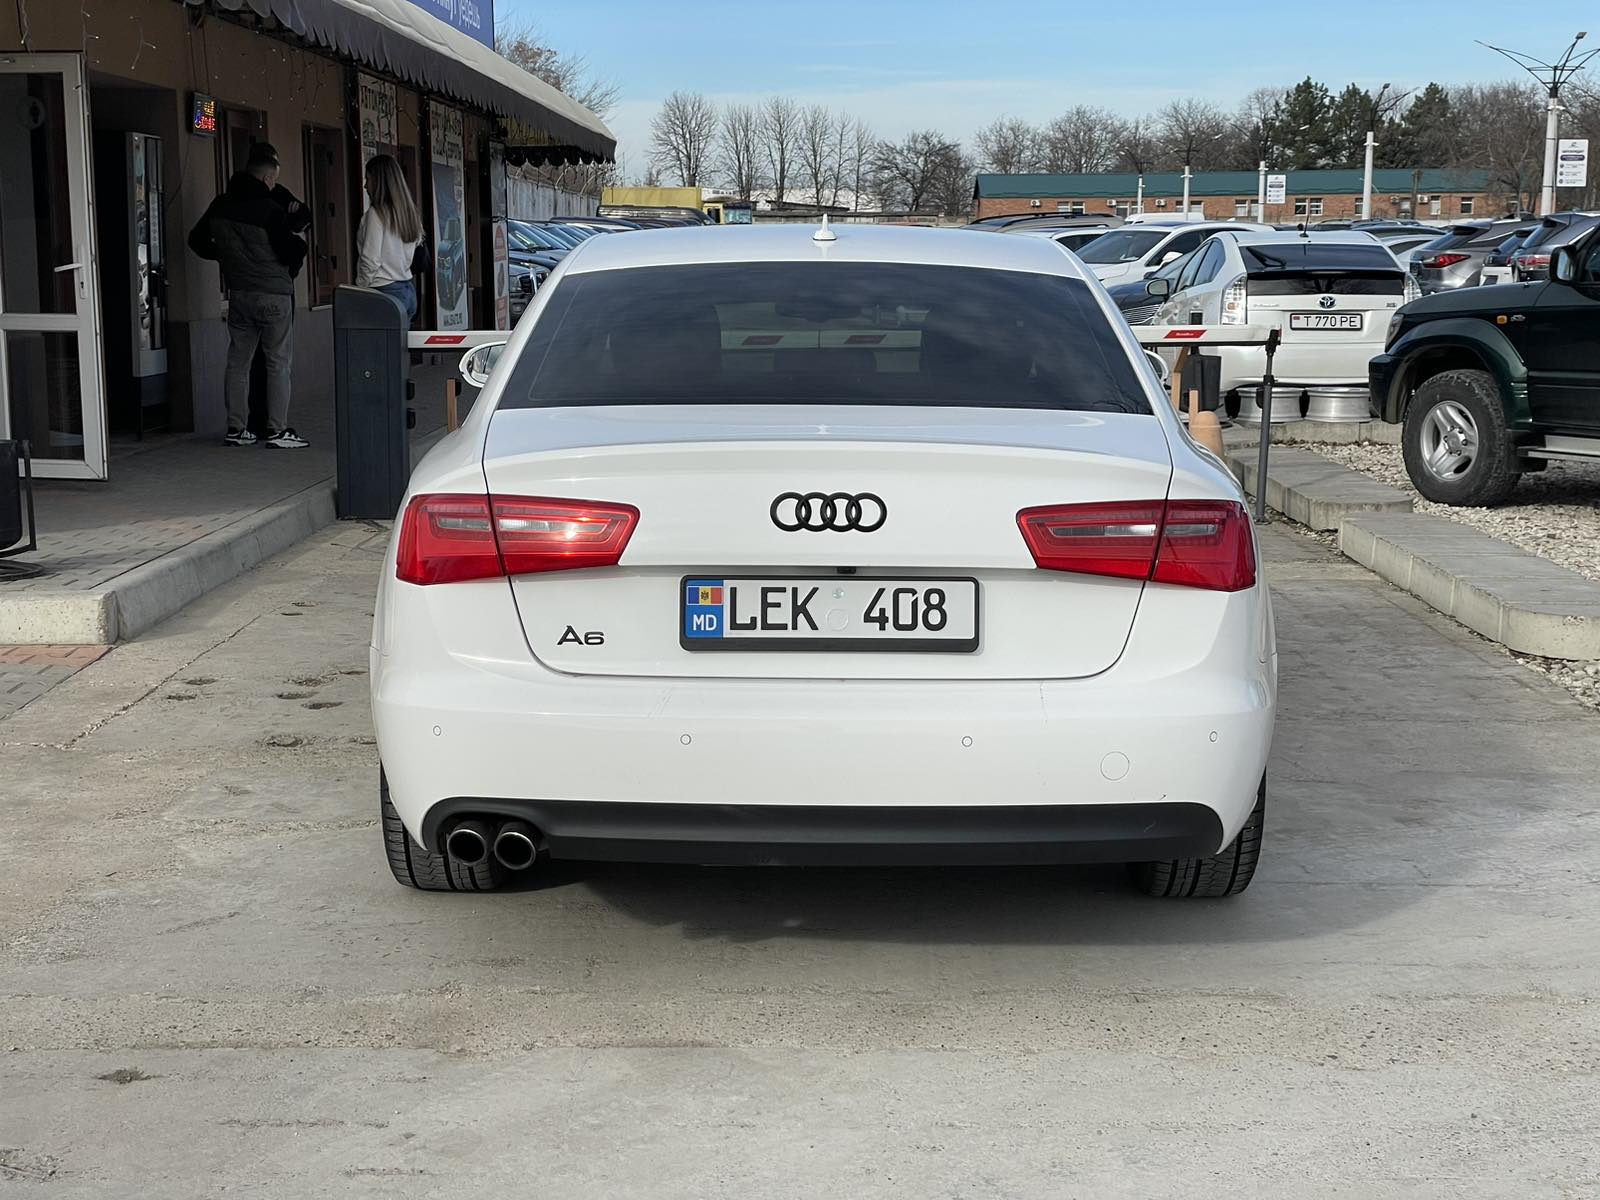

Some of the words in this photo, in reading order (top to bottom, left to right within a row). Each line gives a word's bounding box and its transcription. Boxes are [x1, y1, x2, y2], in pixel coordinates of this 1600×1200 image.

[1303, 316, 1312, 327] T
[1315, 316, 1337, 327] 770
[1340, 316, 1358, 327] PE
[729, 586, 820, 632] LEK
[863, 587, 948, 632] 408
[693, 614, 717, 631] MD
[557, 625, 605, 647] A6
